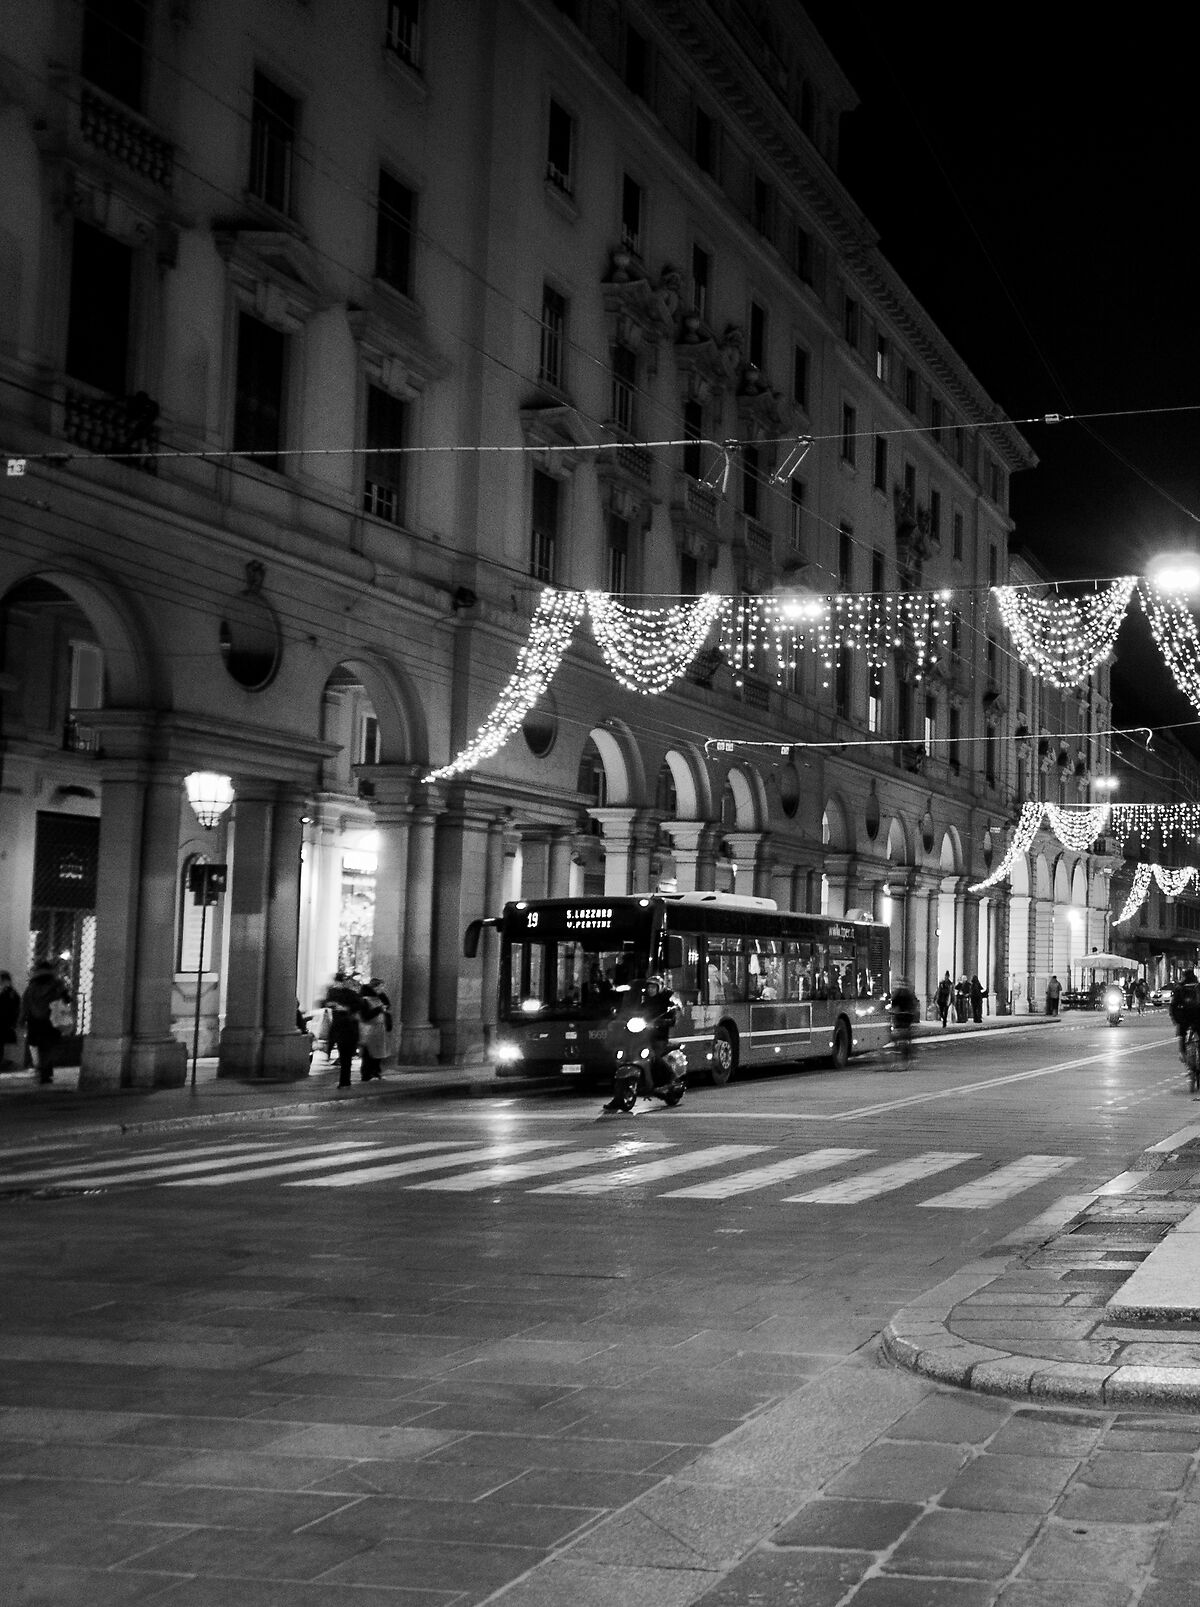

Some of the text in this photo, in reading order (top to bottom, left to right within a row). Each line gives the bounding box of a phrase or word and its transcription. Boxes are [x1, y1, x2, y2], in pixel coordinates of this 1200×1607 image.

[566, 908, 613, 919] S.LAZZARO
[527, 912, 539, 928] 19
[566, 920, 612, 929] V.PERTINI
